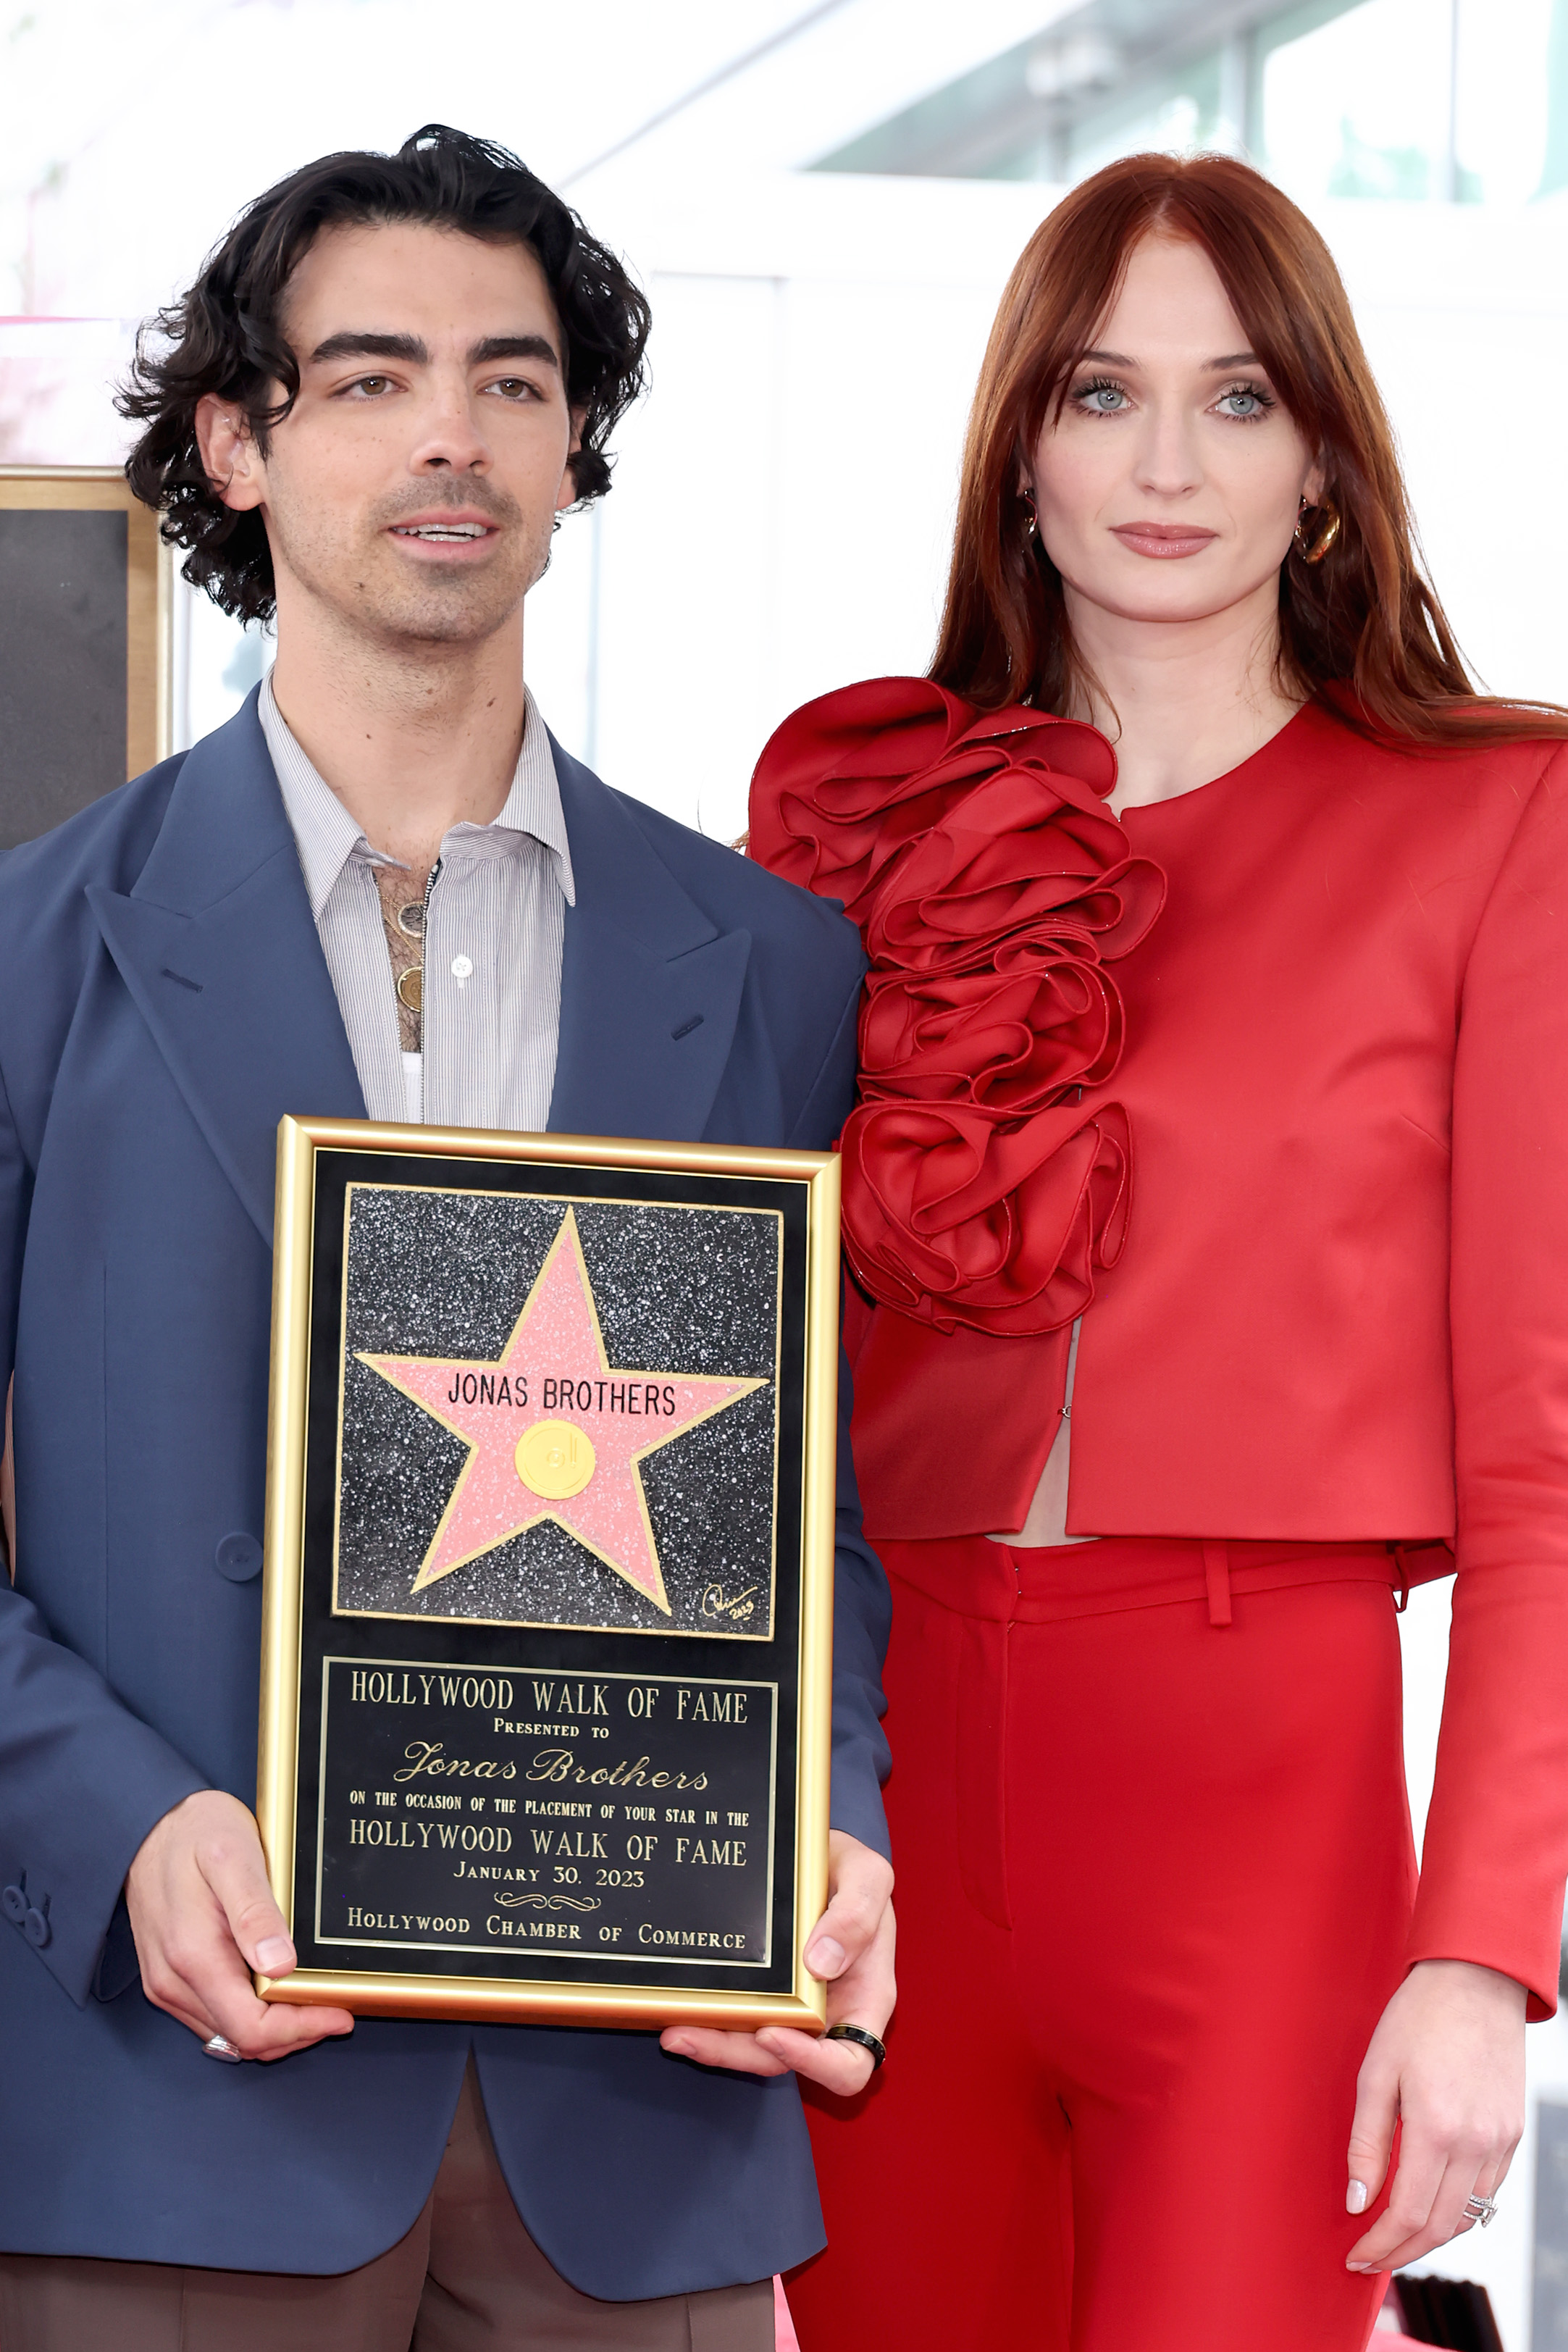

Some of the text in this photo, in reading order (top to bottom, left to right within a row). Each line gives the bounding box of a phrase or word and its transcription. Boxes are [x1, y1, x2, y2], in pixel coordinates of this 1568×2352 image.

[448, 1373, 676, 1416] JONAS BROTHERS
[351, 1670, 748, 1724] HOLLYWOOD WALK OF FAME
[493, 1717, 611, 1739] PRESENTED TO
[393, 1741, 709, 1791] Jonas Brothers
[349, 1790, 750, 1827] ON THE OCCASION OF THE PLACEMENT OF YOUR STAR IN THE
[349, 1819, 748, 1867] HOLLYWOOD WALK OF FAME
[453, 1861, 540, 1882] JANUARY
[595, 1869, 645, 1888] 2023
[348, 1907, 746, 1949] HOLLYWOOD CHAMBER OF COMMERCE
